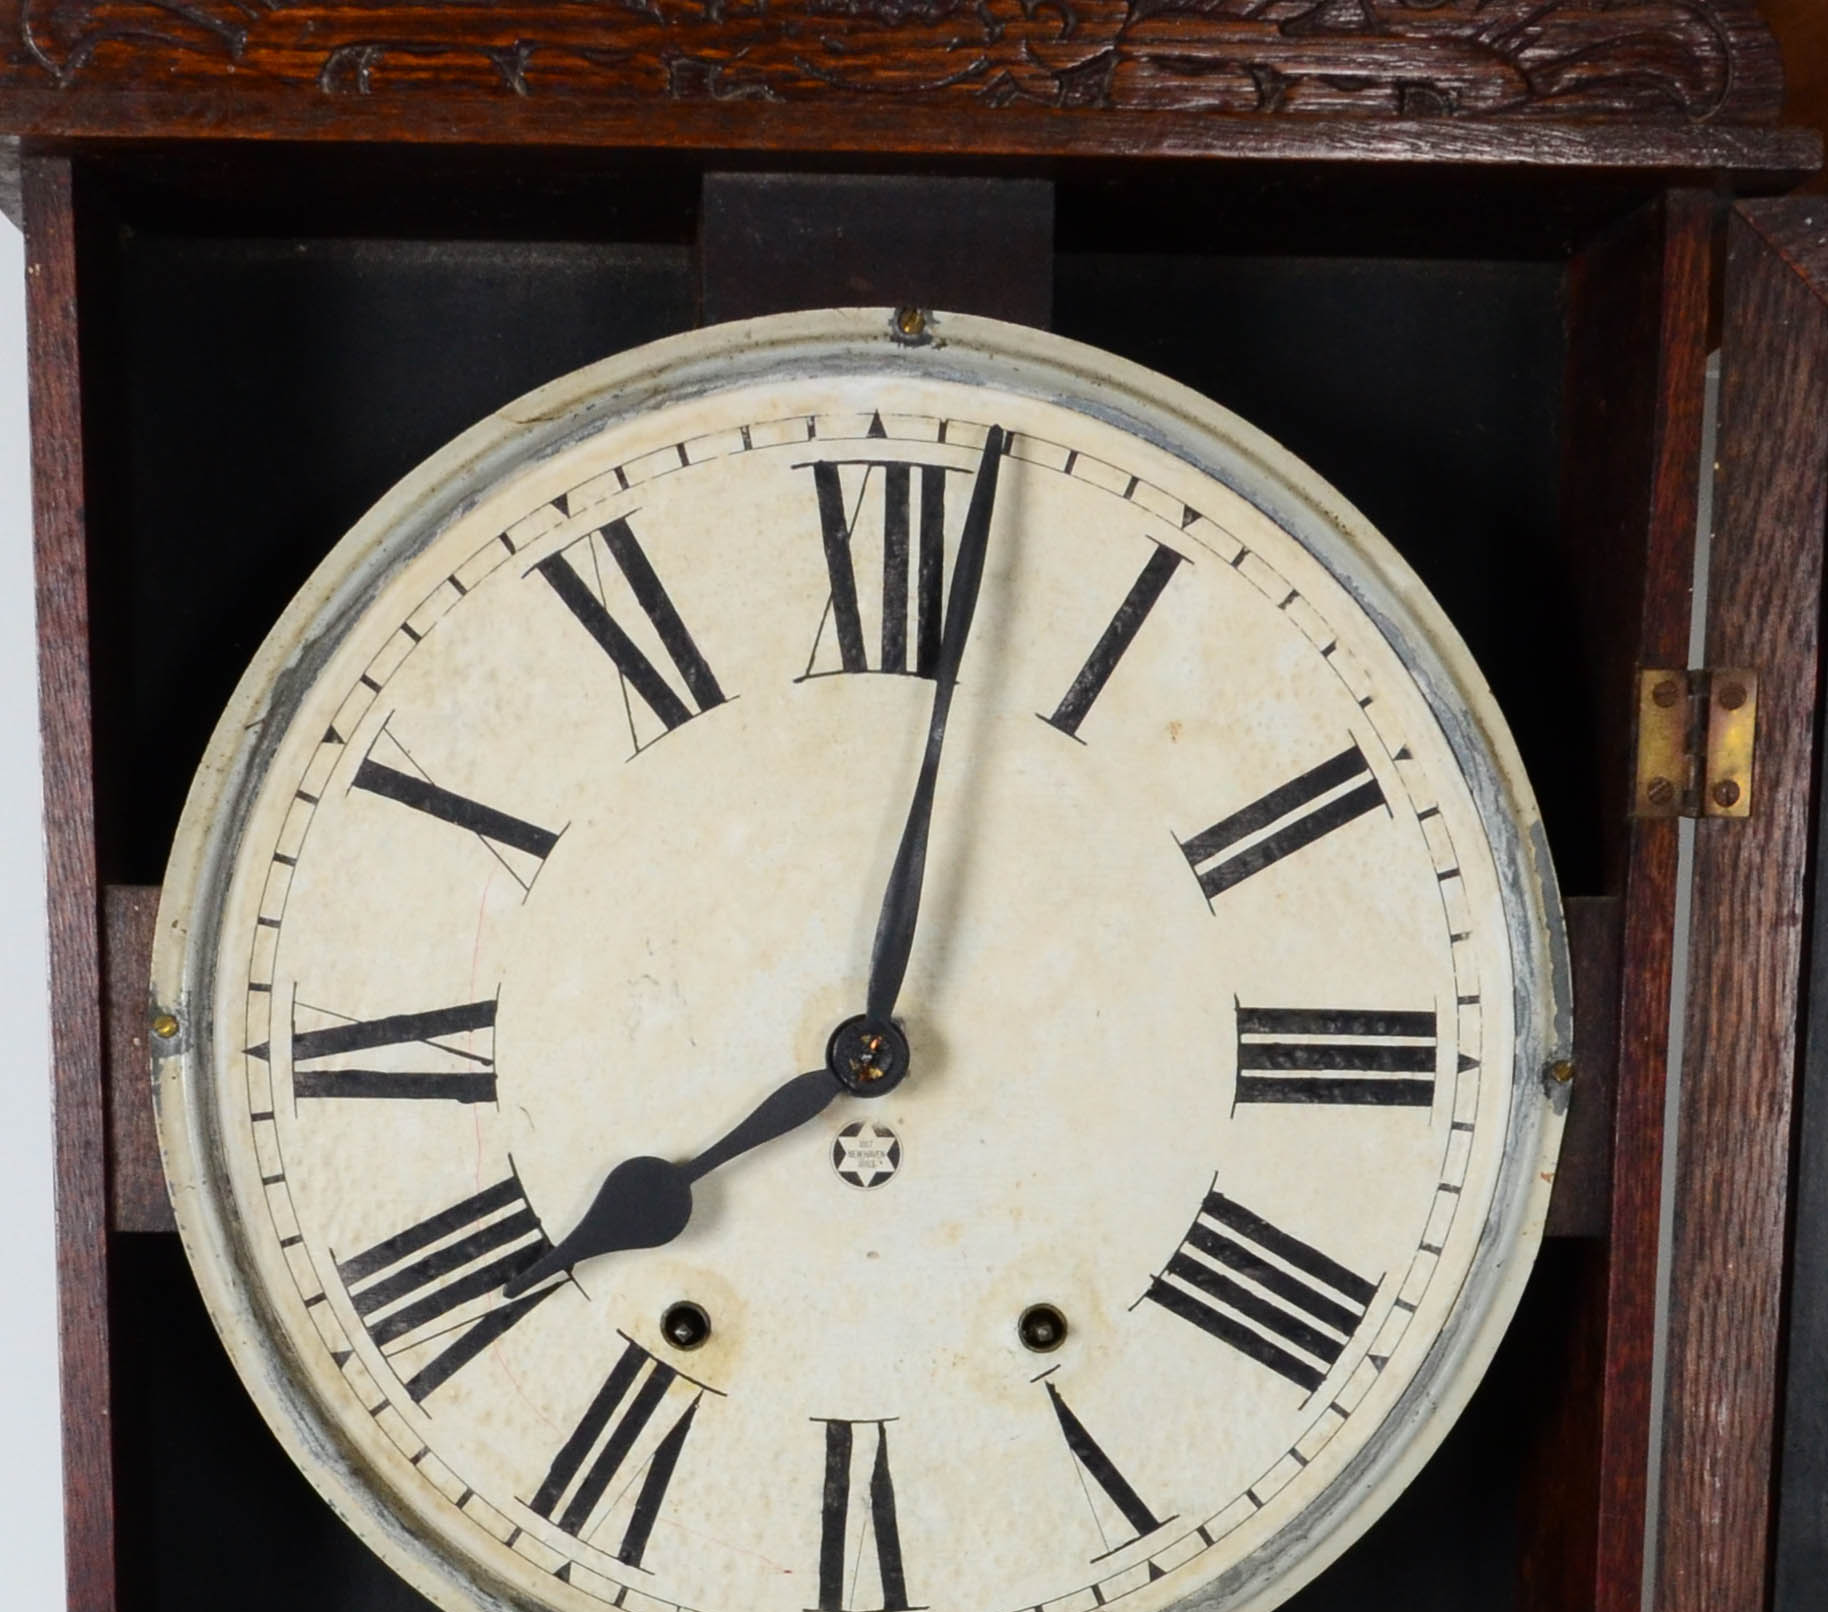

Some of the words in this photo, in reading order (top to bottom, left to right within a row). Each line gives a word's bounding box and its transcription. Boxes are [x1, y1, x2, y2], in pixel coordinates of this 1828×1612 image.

[521, 507, 740, 763] XI
[791, 460, 973, 685] XII
[1035, 535, 1195, 746] I
[345, 708, 571, 906] X
[1170, 729, 1394, 916] II
[290, 981, 501, 1119] IX
[1231, 993, 1438, 1126] III
[329, 1152, 592, 1420] VIII
[1128, 1170, 1387, 1411] IIII
[514, 1328, 728, 1575] VII
[1030, 1364, 1180, 1563] V
